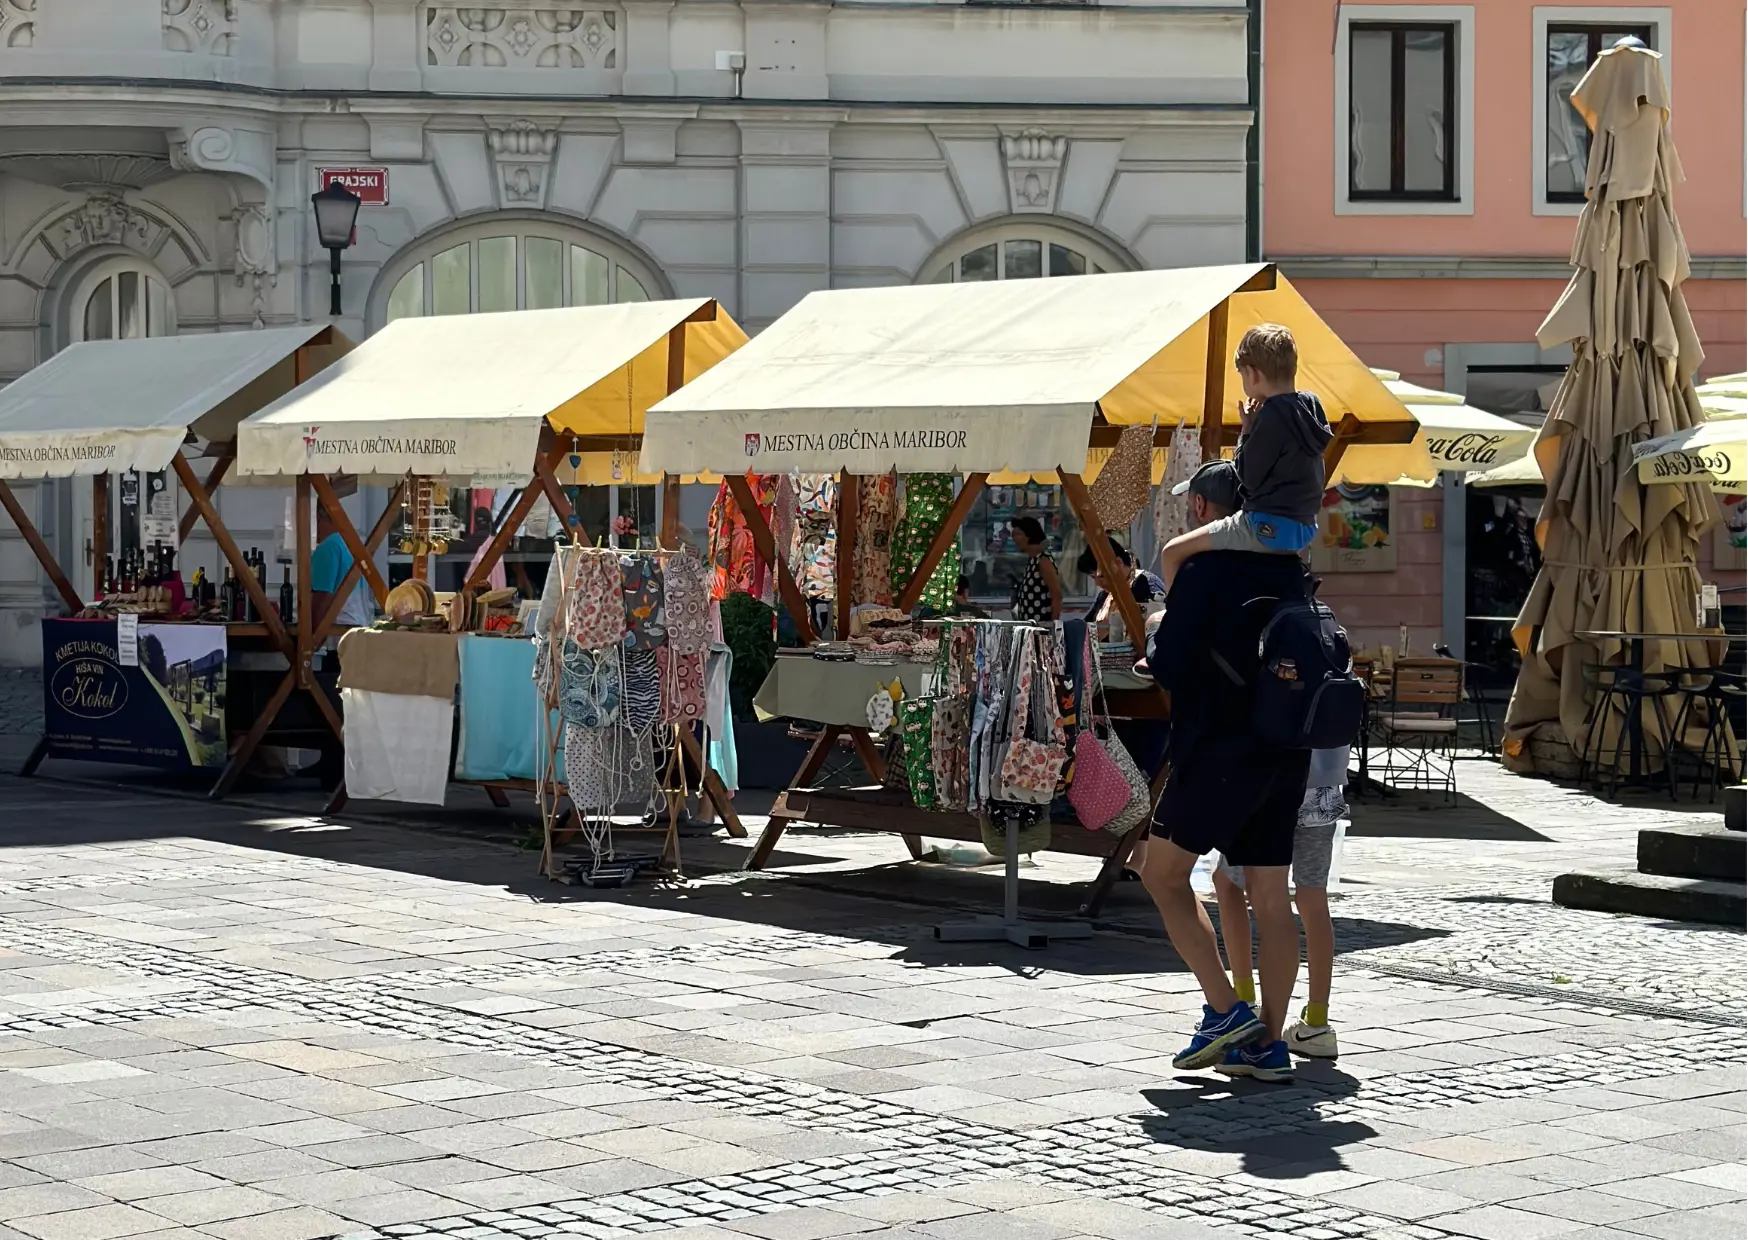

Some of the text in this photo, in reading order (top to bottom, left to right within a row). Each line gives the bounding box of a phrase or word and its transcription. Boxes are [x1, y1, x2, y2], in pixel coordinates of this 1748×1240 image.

[315, 435, 457, 455] MESTNA OBČINA MARIBOR
[764, 428, 967, 452] MESTNA OBČINA MARIBOR
[0, 445, 116, 461] MESTNA OBČINA MARIBOR
[55, 640, 91, 662] KMETIJA
[90, 640, 119, 665] KOKOL
[76, 662, 104, 675] HIŠA VIN
[62, 675, 118, 708] Kokol
